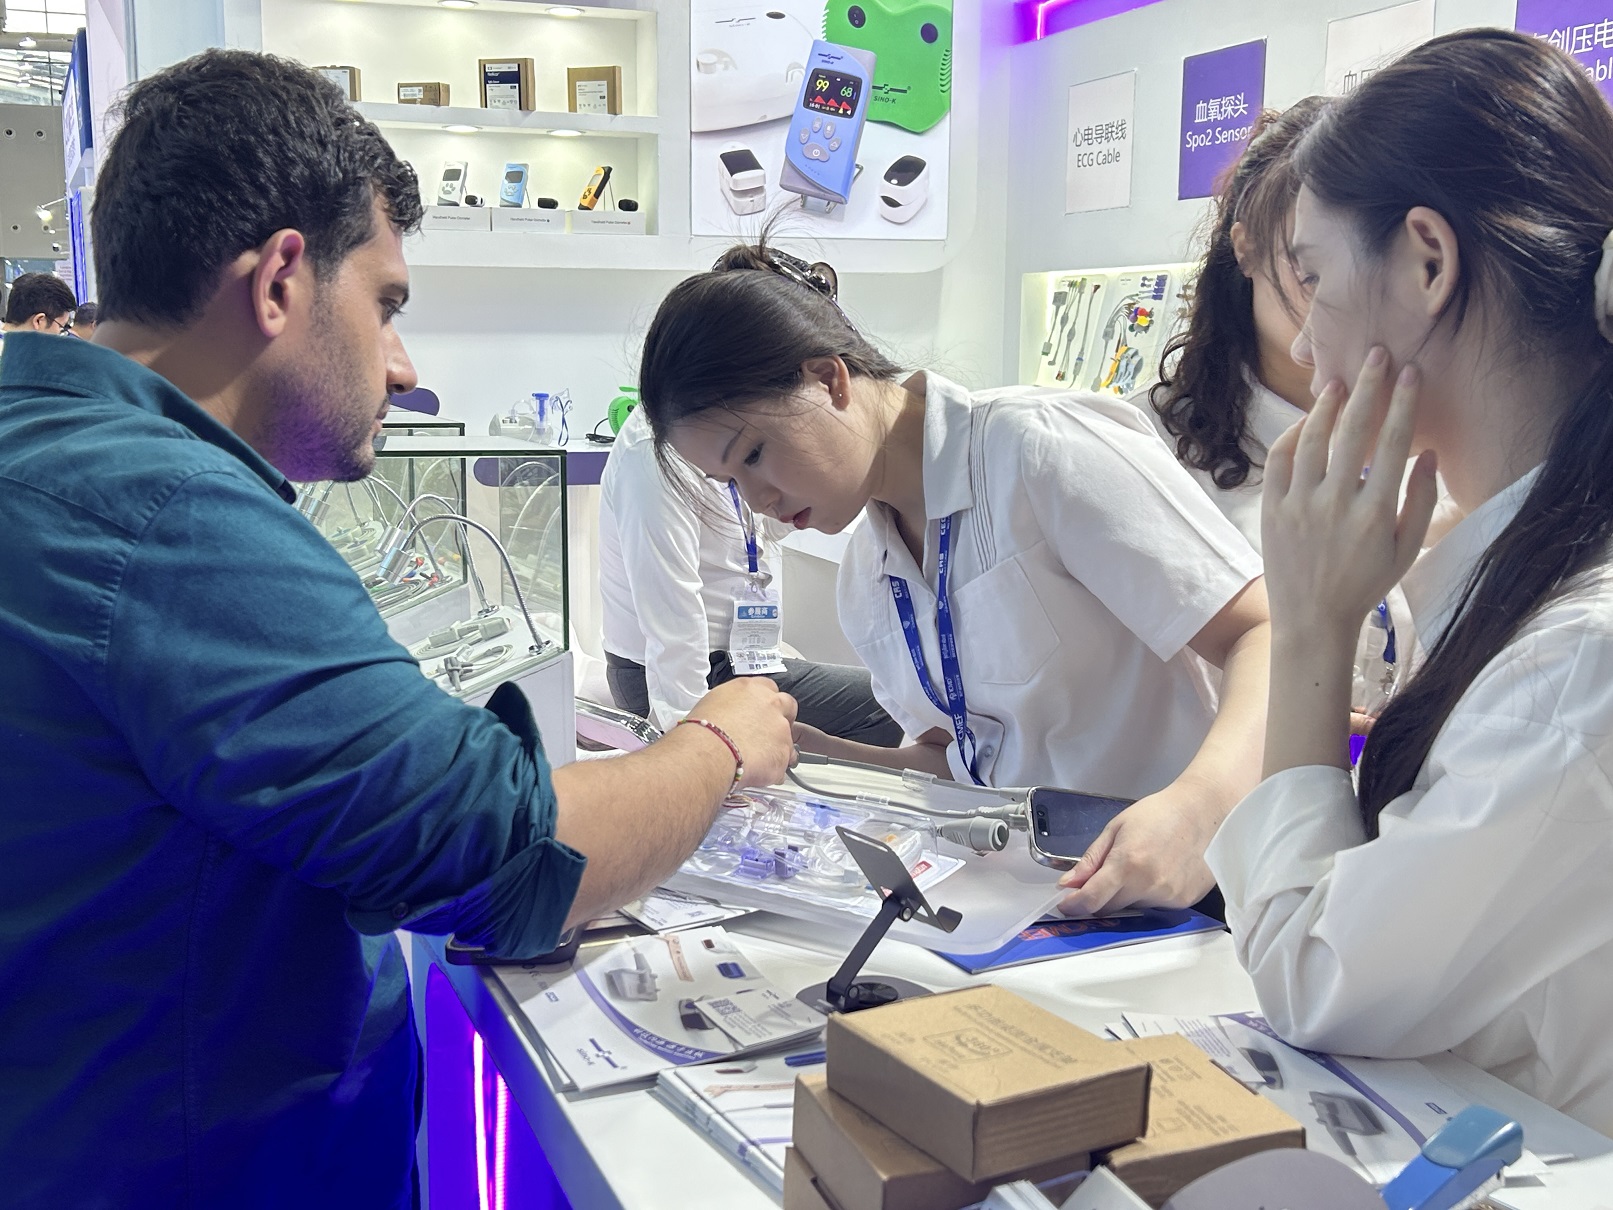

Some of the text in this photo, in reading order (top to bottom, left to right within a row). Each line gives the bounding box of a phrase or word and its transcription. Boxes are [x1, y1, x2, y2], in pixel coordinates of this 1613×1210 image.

[815, 79, 830, 92] 99
[840, 86, 853, 98] 68
[873, 95, 897, 104] SINO-K
[1194, 92, 1249, 123] 血氧探头
[1072, 119, 1127, 148] 心电导联线
[1185, 128, 1212, 152] Spo2
[1077, 148, 1121, 168] ECG Cable
[954, 713, 964, 740] CMEF
